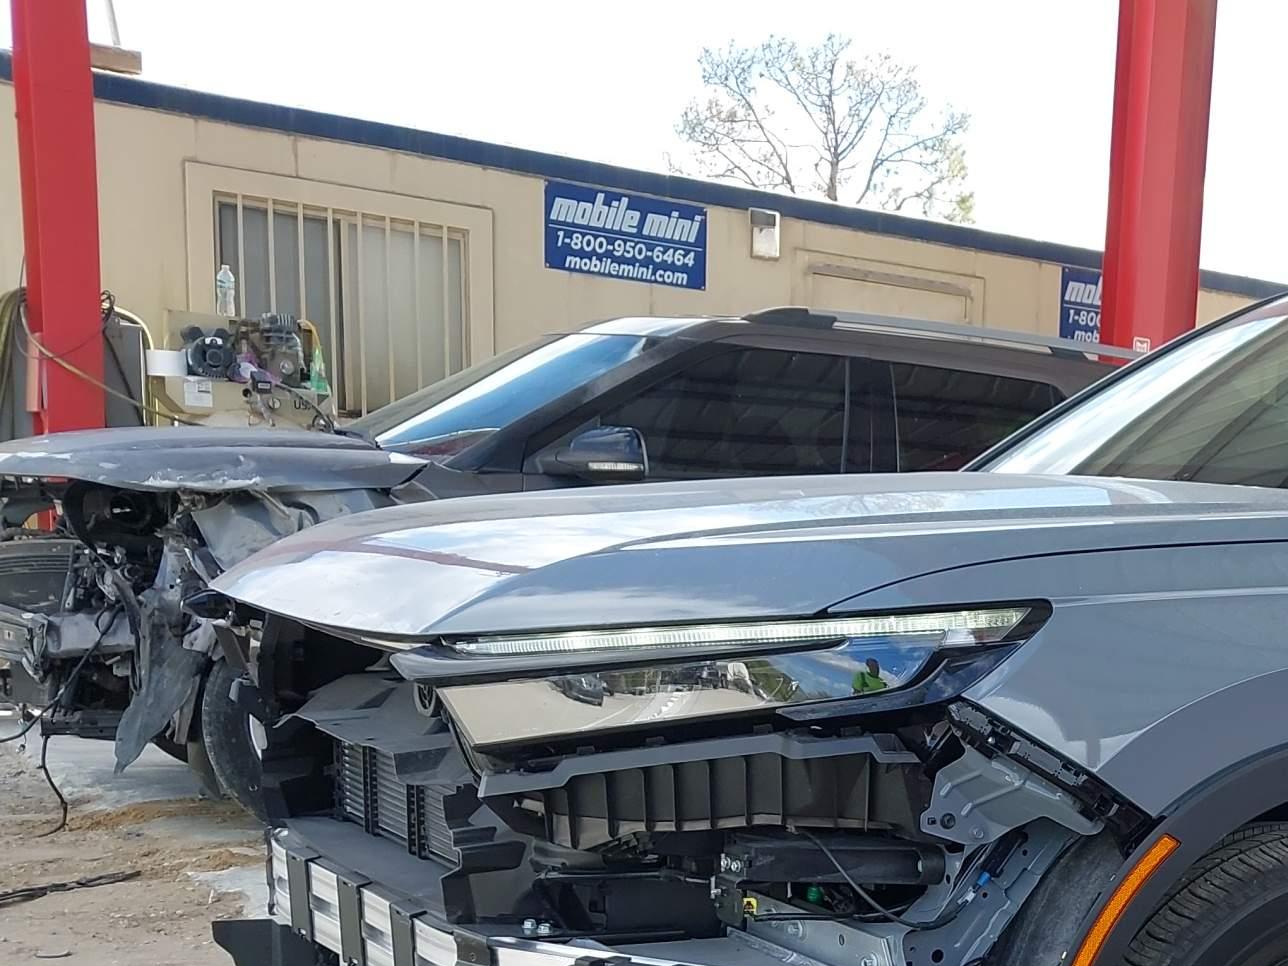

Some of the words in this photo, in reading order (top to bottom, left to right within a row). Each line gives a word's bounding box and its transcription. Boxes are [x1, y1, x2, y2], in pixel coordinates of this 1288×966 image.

[550, 193, 641, 233] mobile
[642, 211, 702, 243] mini
[556, 230, 695, 267] 1-800-950-6464
[565, 254, 688, 285] mobilemini.com
